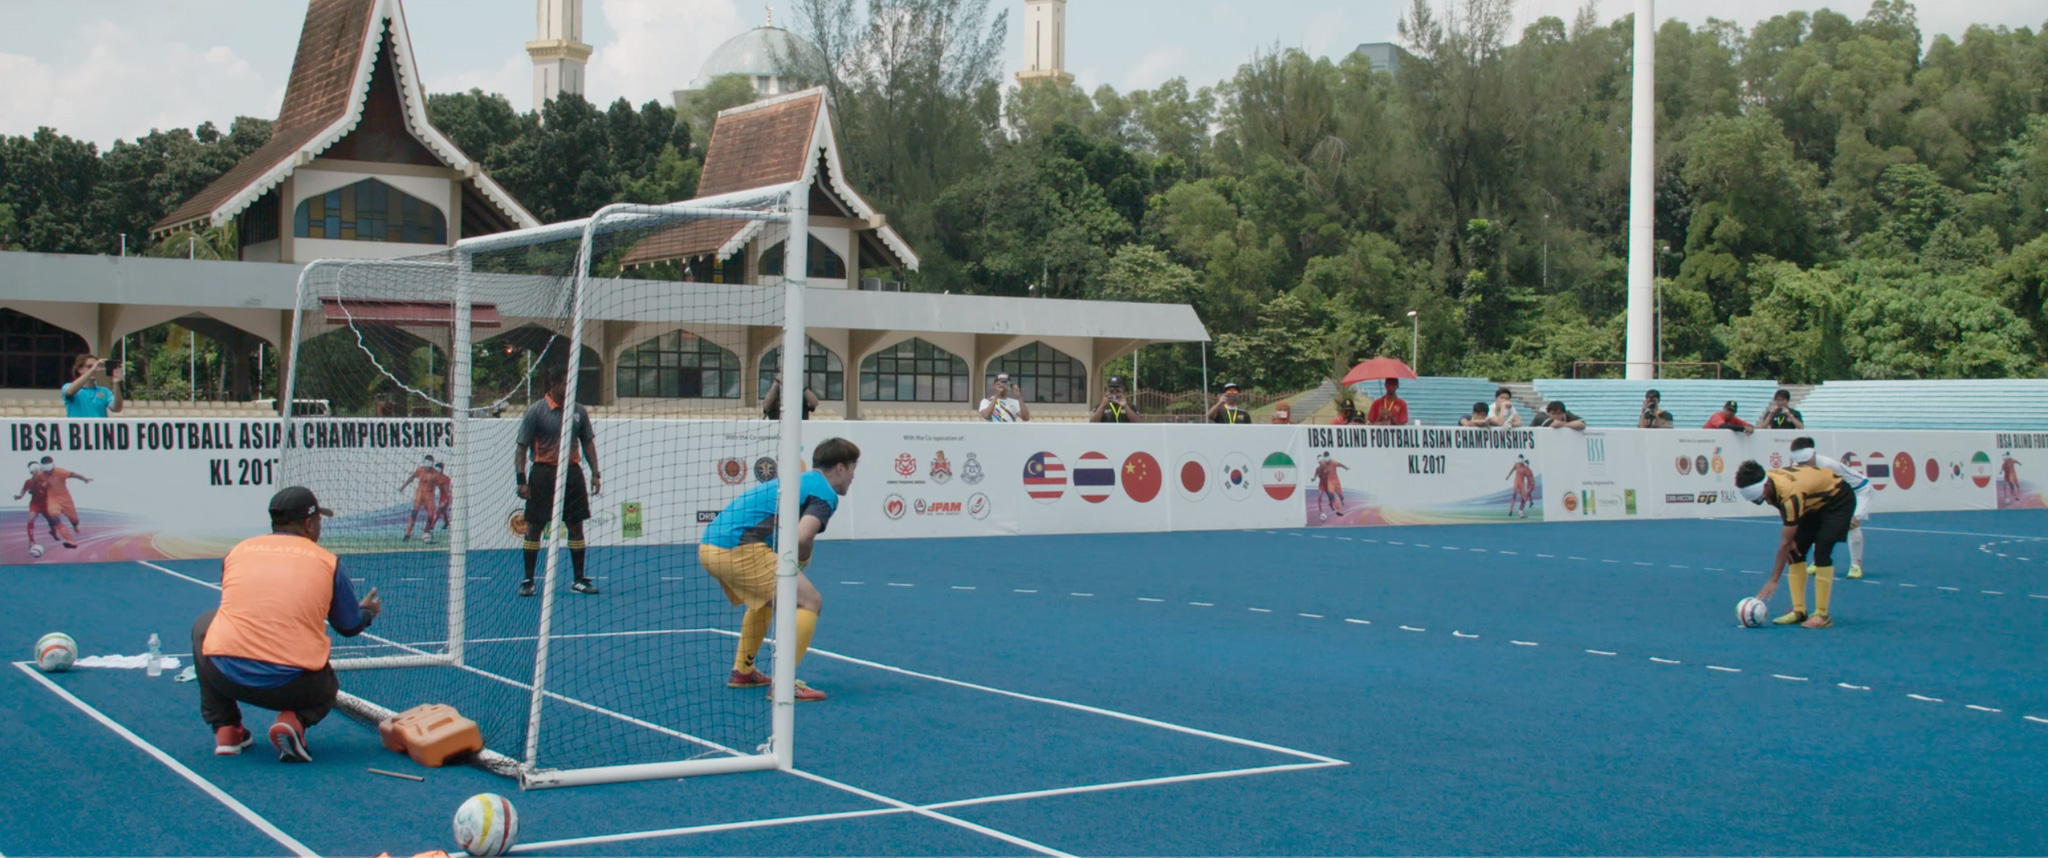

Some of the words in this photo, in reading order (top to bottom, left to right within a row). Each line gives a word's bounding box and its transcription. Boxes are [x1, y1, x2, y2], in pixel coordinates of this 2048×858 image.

[11, 422, 62, 451] IBSA
[69, 422, 130, 451] BLIND
[137, 422, 233, 450] FOOTBALL
[239, 422, 297, 449] ASIAN
[302, 421, 454, 449] CHAMPIONSHIPS
[1308, 427, 1334, 448] IBSA
[1336, 428, 1368, 448] BLIND
[1370, 428, 1420, 449] FOOTBALL
[1422, 429, 1452, 449] ASIAN
[1455, 429, 1535, 450] CHAMPIONSHIPS
[1996, 433, 2012, 449] IBSA
[2013, 433, 2032, 449] BLIND
[210, 458, 233, 486] KL
[1408, 454, 1420, 474] KL
[1422, 455, 1445, 474] 2017
[928, 502, 962, 512] JPAM
[243, 545, 316, 558] MALAYSIA
